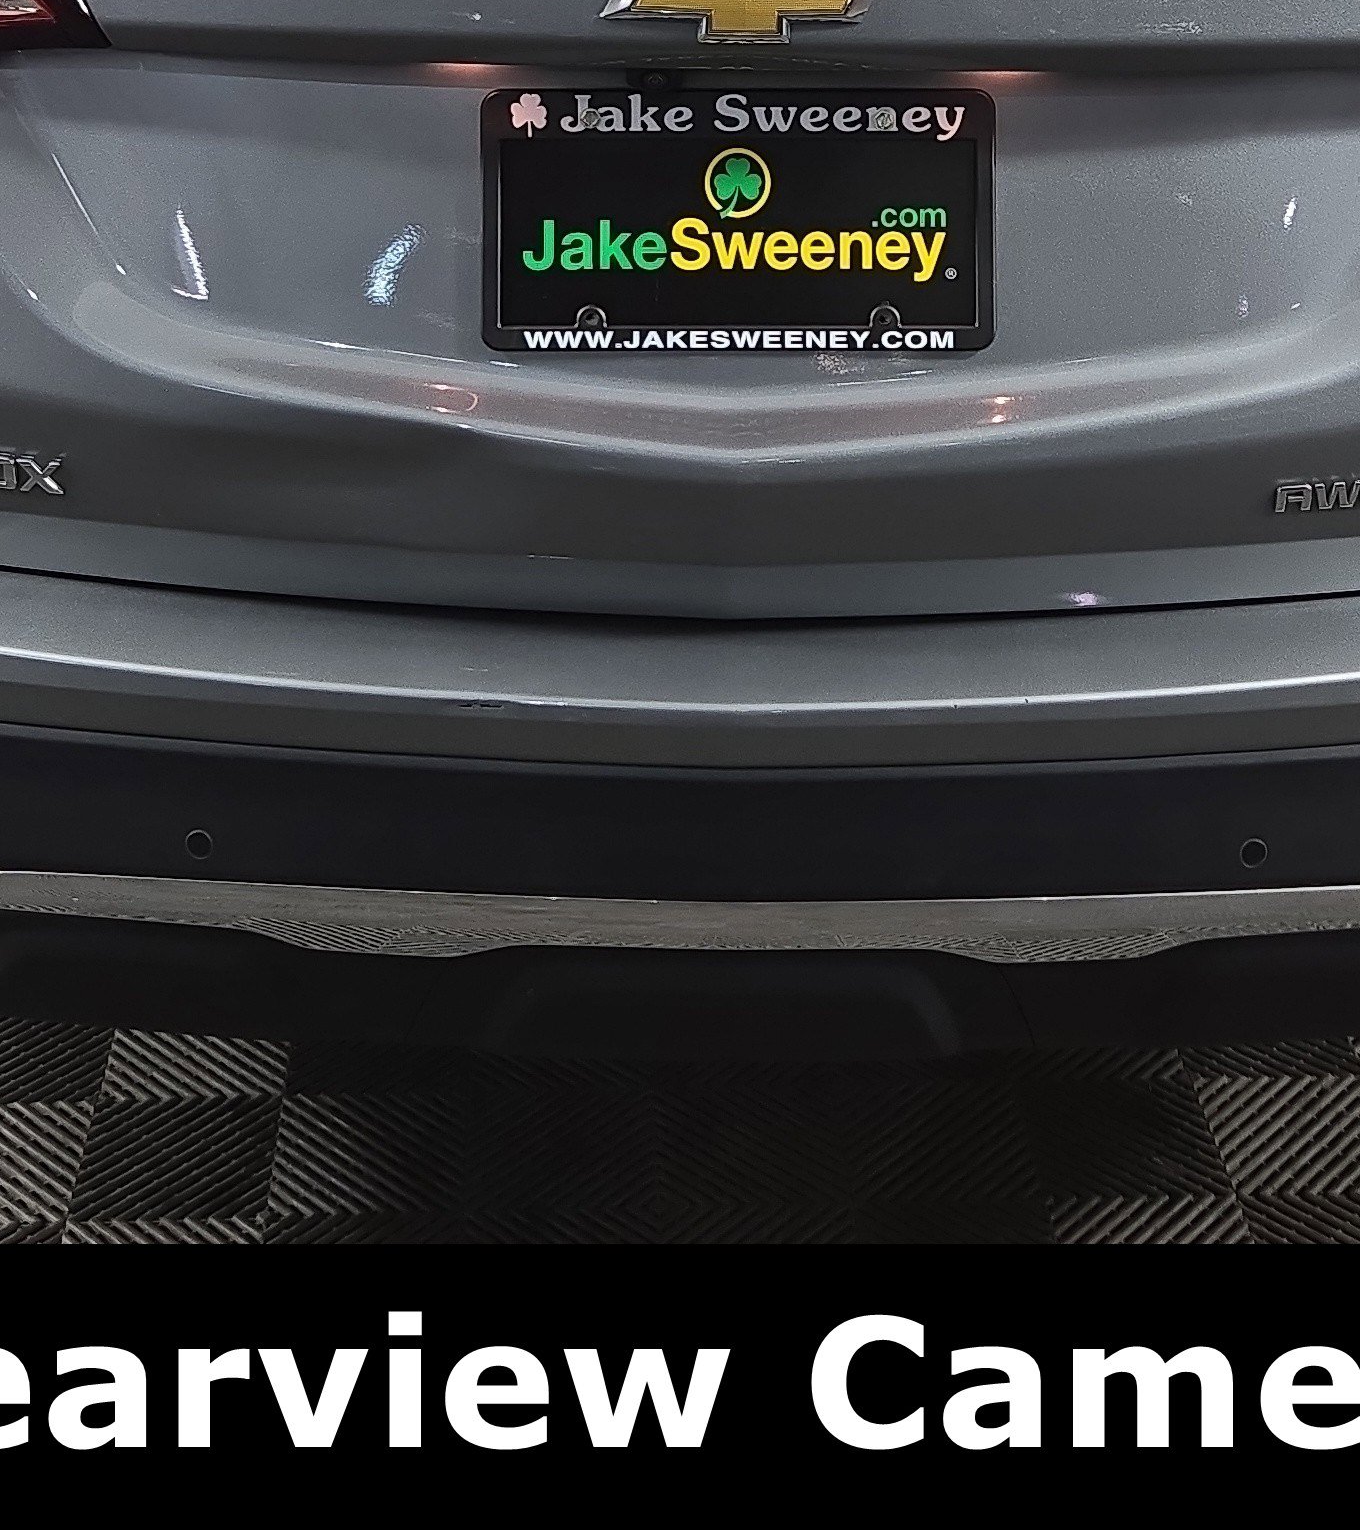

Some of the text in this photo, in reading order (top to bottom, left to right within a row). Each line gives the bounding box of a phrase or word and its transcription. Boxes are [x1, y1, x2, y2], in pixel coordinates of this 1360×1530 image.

[560, 94, 966, 140] Jake Sweeney
[523, 329, 955, 349] WWW.JAKESWEENEY.COM
